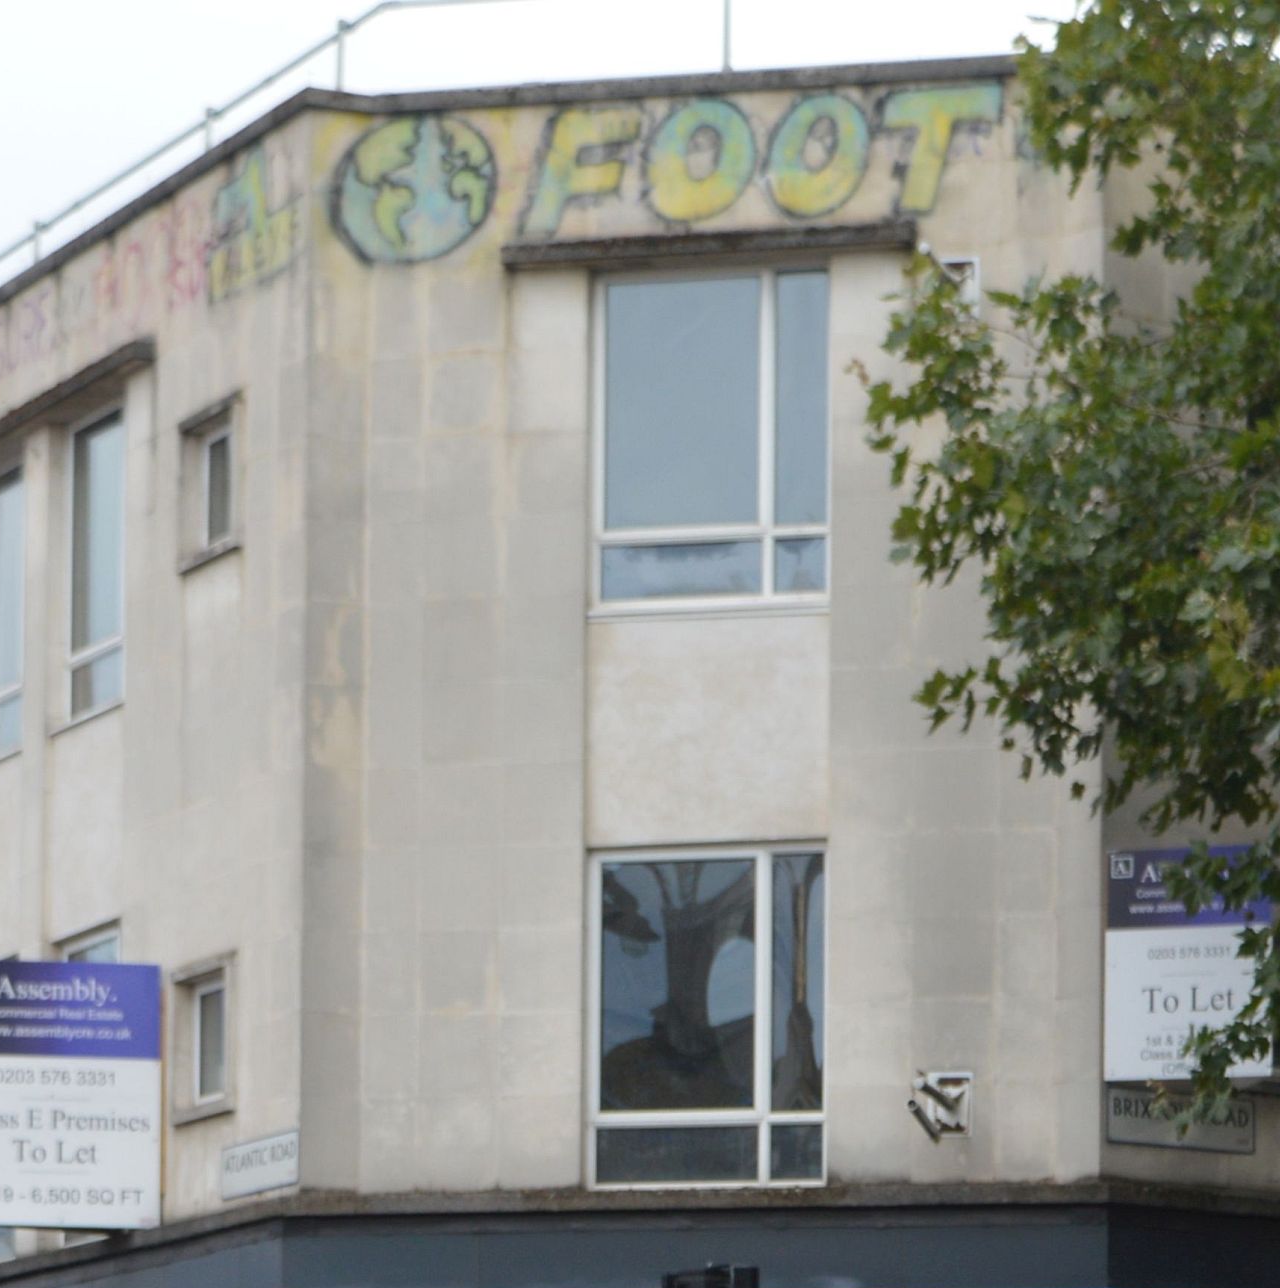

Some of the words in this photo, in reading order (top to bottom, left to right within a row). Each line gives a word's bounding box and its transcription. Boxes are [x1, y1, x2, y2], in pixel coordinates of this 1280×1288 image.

[1148, 948, 1176, 960] 0203
[1142, 986, 1179, 1013] To
[1191, 985, 1234, 1012] Let
[41, 1069, 71, 1086] 576
[76, 1070, 117, 1087] 3331
[27, 1108, 44, 1130] E
[50, 1108, 151, 1132] Premises
[12, 1139, 48, 1165] To
[56, 1140, 98, 1165] Let
[86, 1189, 115, 1206] SQ
[120, 1190, 144, 1206] FT
